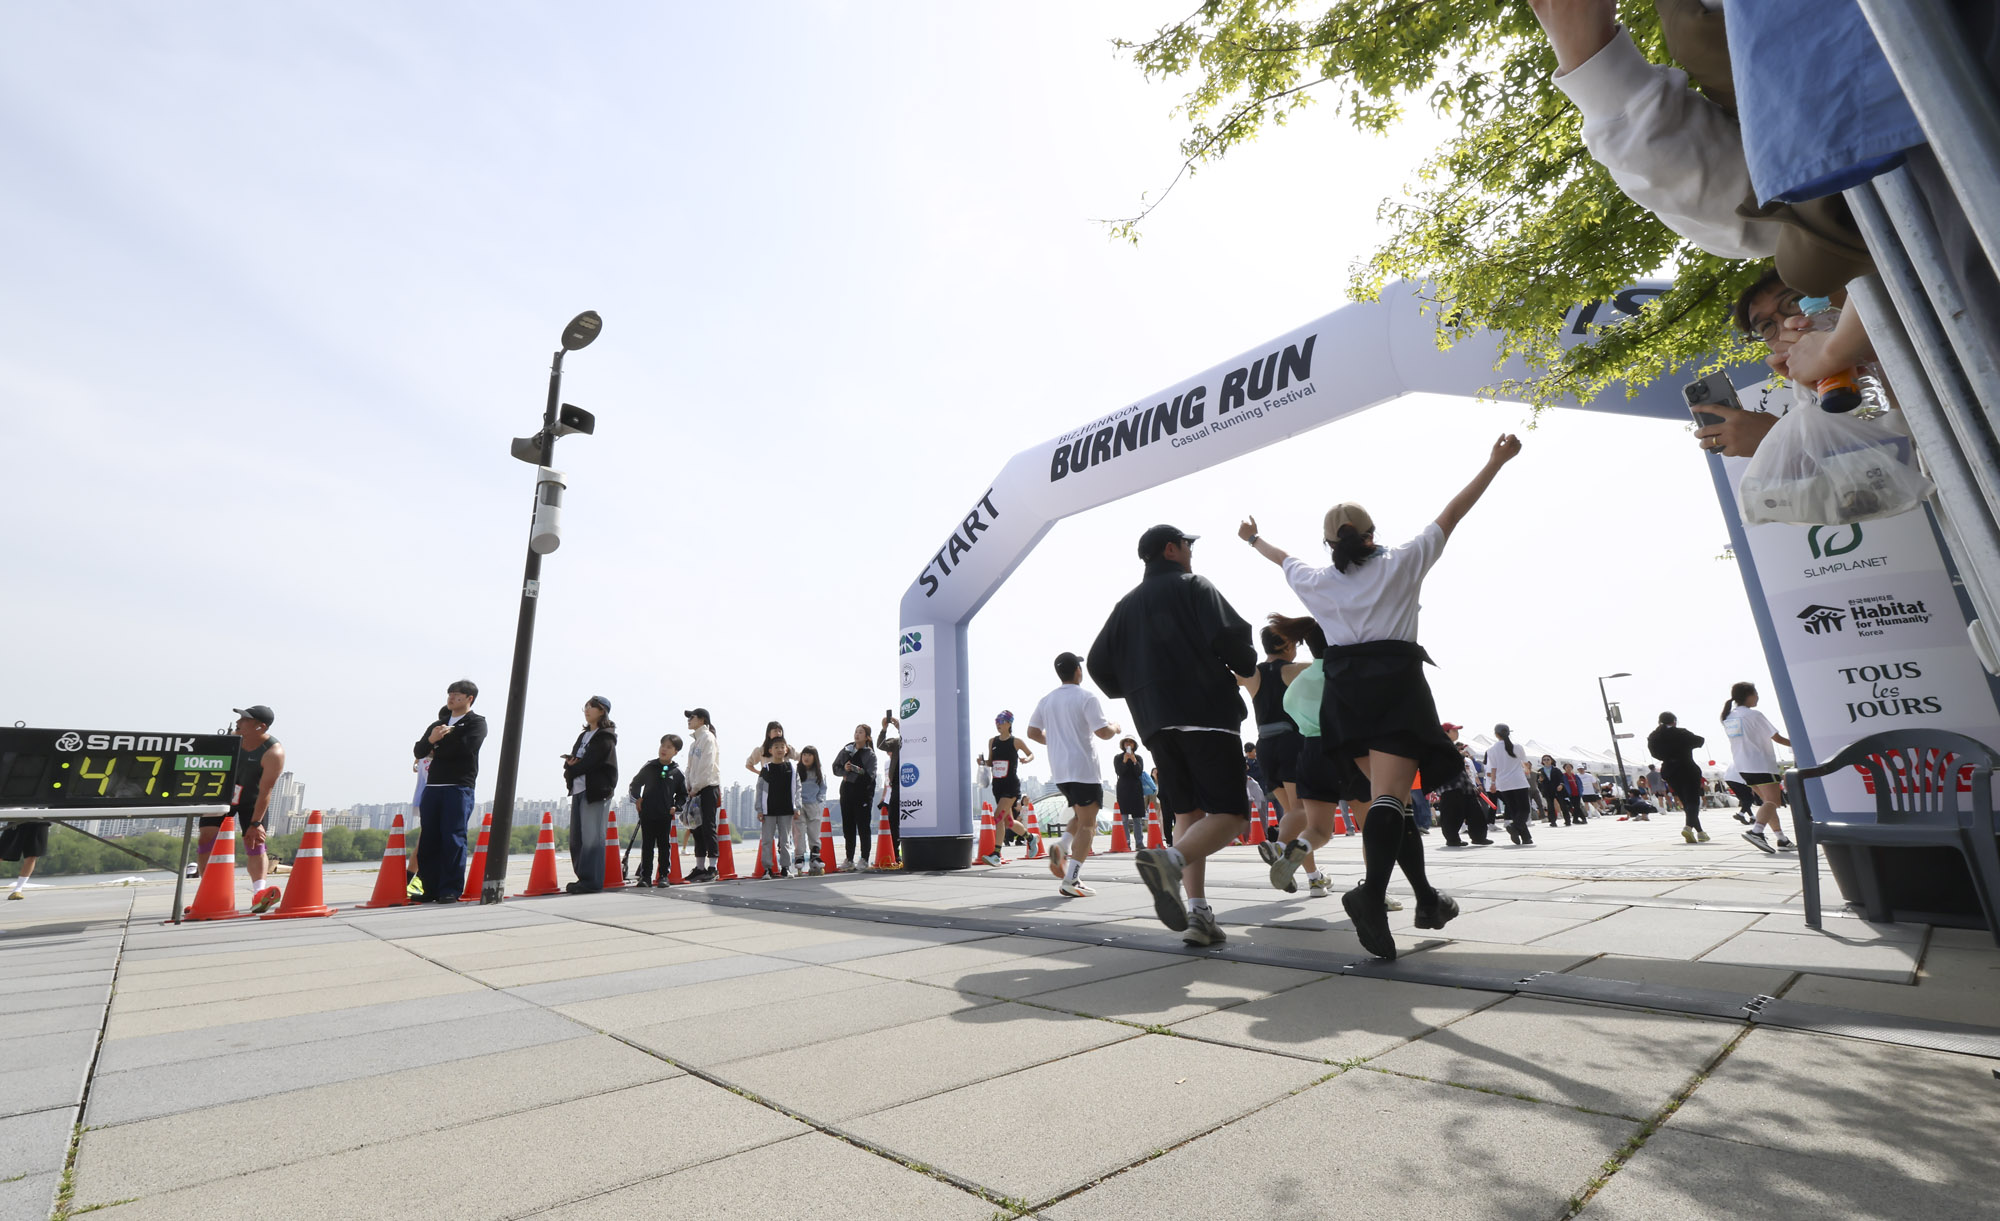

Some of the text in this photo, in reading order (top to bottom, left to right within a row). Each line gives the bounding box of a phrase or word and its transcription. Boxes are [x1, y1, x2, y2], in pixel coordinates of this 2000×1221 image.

[1050, 334, 1318, 482] BURNING RUN
[1171, 383, 1317, 449] Casual Running Festival
[919, 487, 999, 598] START
[1803, 556, 1888, 578] SLIMPLANET
[1850, 600, 1927, 620] Habitat
[1856, 620, 1872, 629] for
[1858, 629, 1884, 638] Korea
[1838, 661, 1922, 684] TOUS
[1872, 682, 1900, 699] les
[1846, 696, 1942, 723] JOURS
[87, 734, 196, 752] SAMIK
[183, 756, 224, 769] 10km
